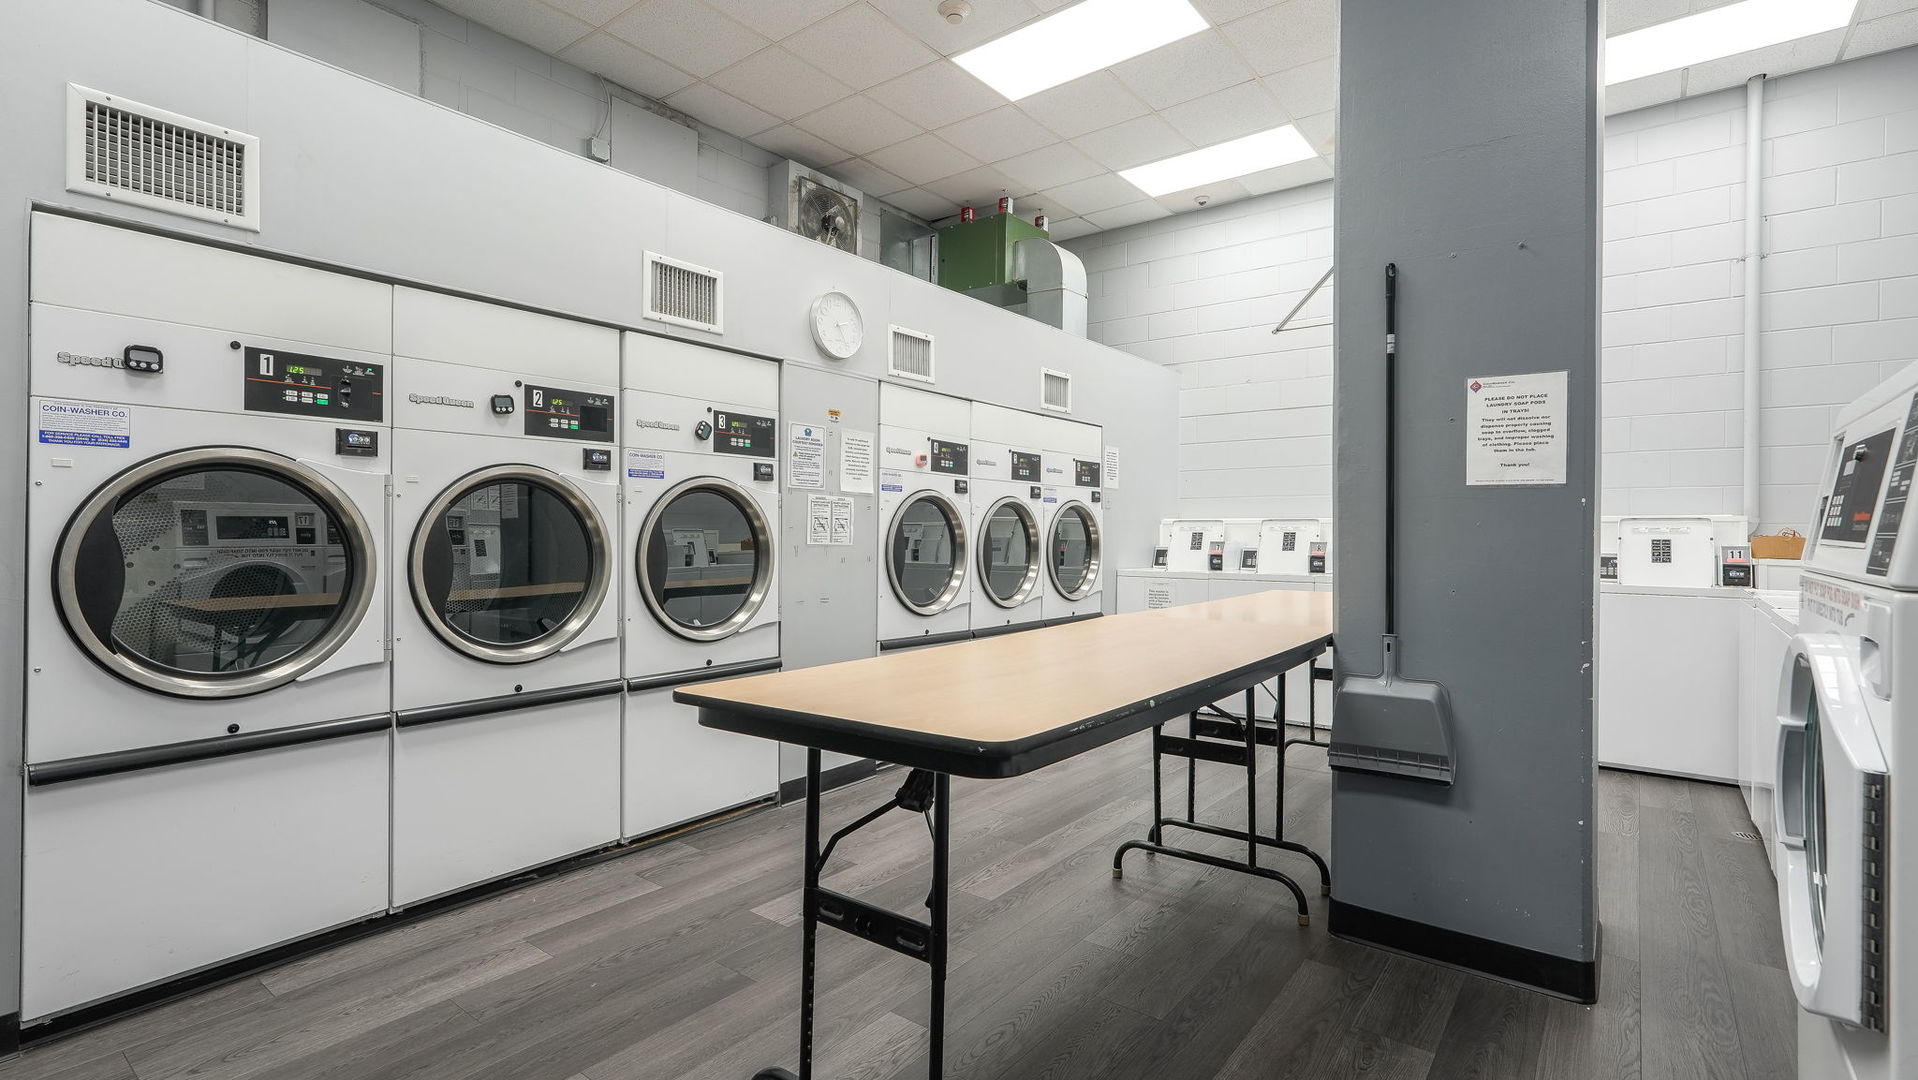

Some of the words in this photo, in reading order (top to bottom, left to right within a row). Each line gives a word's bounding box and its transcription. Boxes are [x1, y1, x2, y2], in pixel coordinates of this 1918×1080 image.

[57, 351, 112, 368] Speed
[263, 356, 271, 374] 1
[408, 393, 442, 405] Speed
[442, 396, 474, 408] Queen
[535, 391, 542, 406] 2
[42, 404, 110, 416] COIN-WASHER
[720, 416, 725, 428] 3
[1730, 550, 1742, 559] 11
